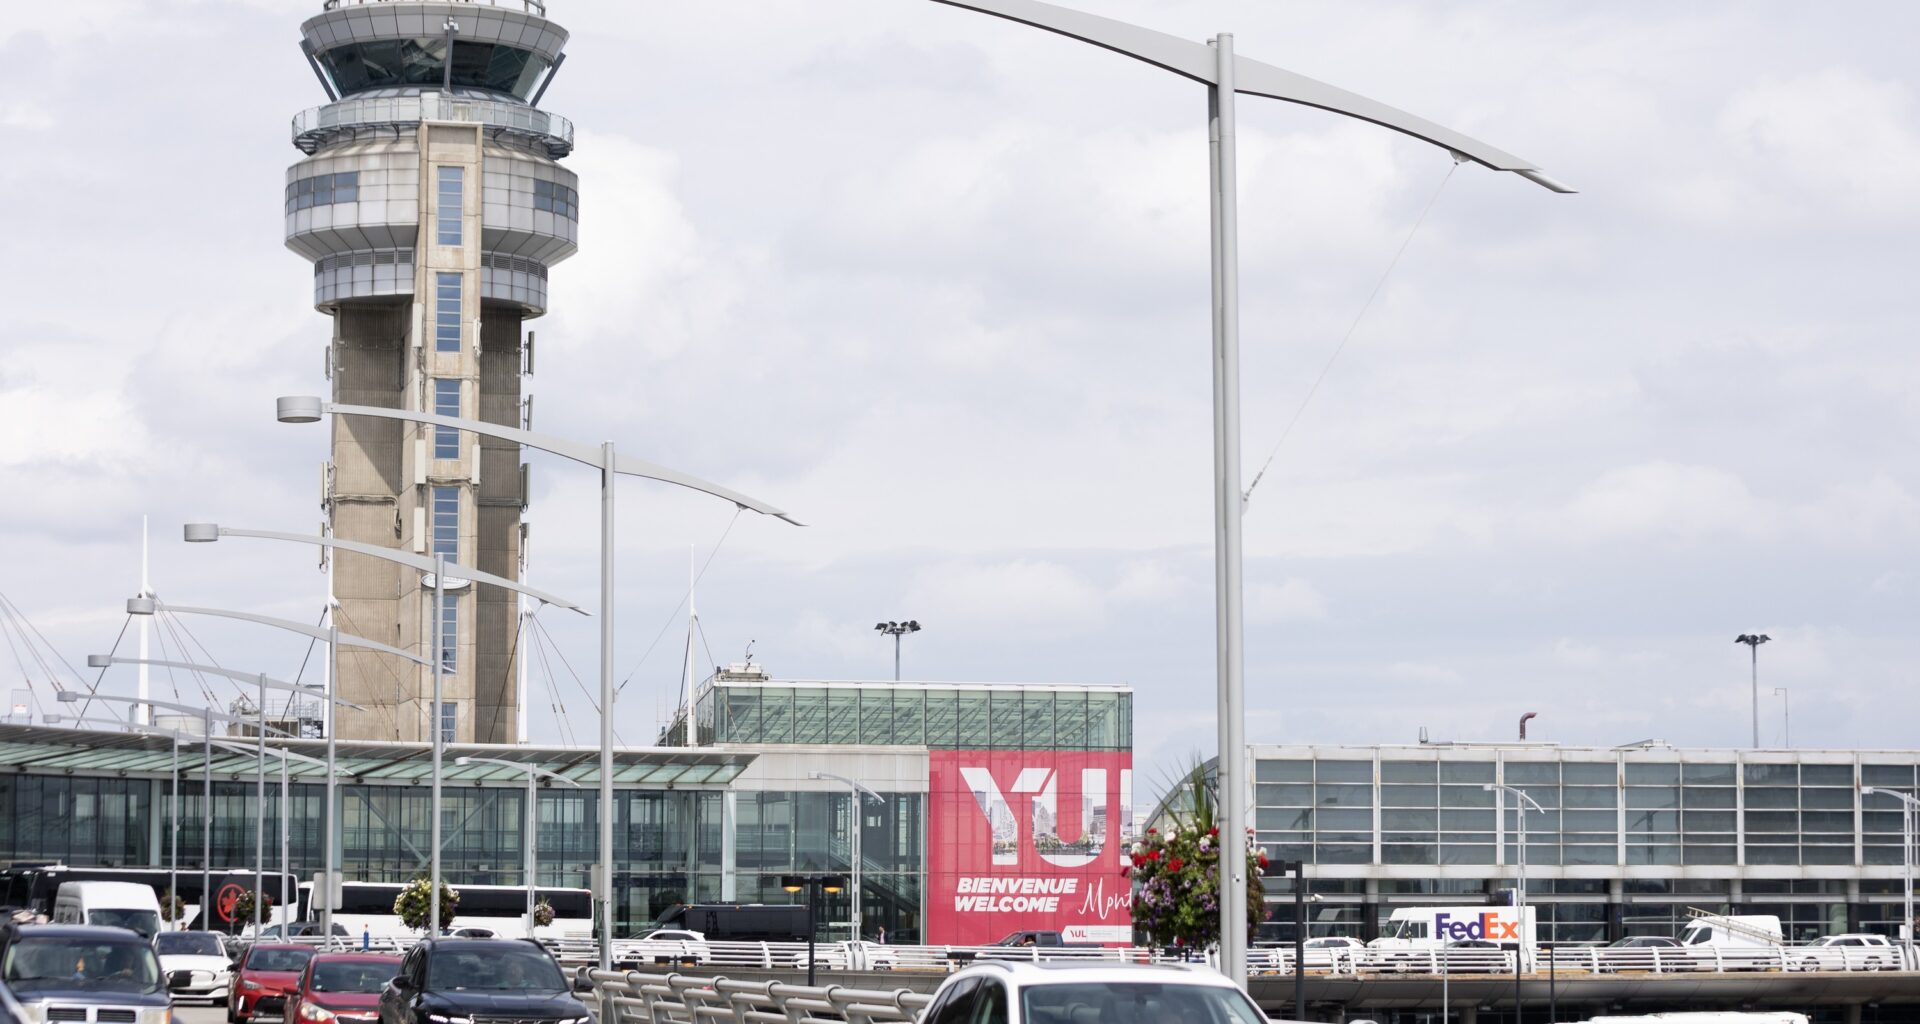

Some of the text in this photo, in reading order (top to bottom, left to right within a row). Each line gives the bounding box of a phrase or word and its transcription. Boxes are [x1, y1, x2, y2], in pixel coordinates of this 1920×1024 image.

[957, 877, 1078, 894] BIENVENUE
[955, 896, 1060, 912] WELCOME
[1435, 912, 1519, 941] FedEx
